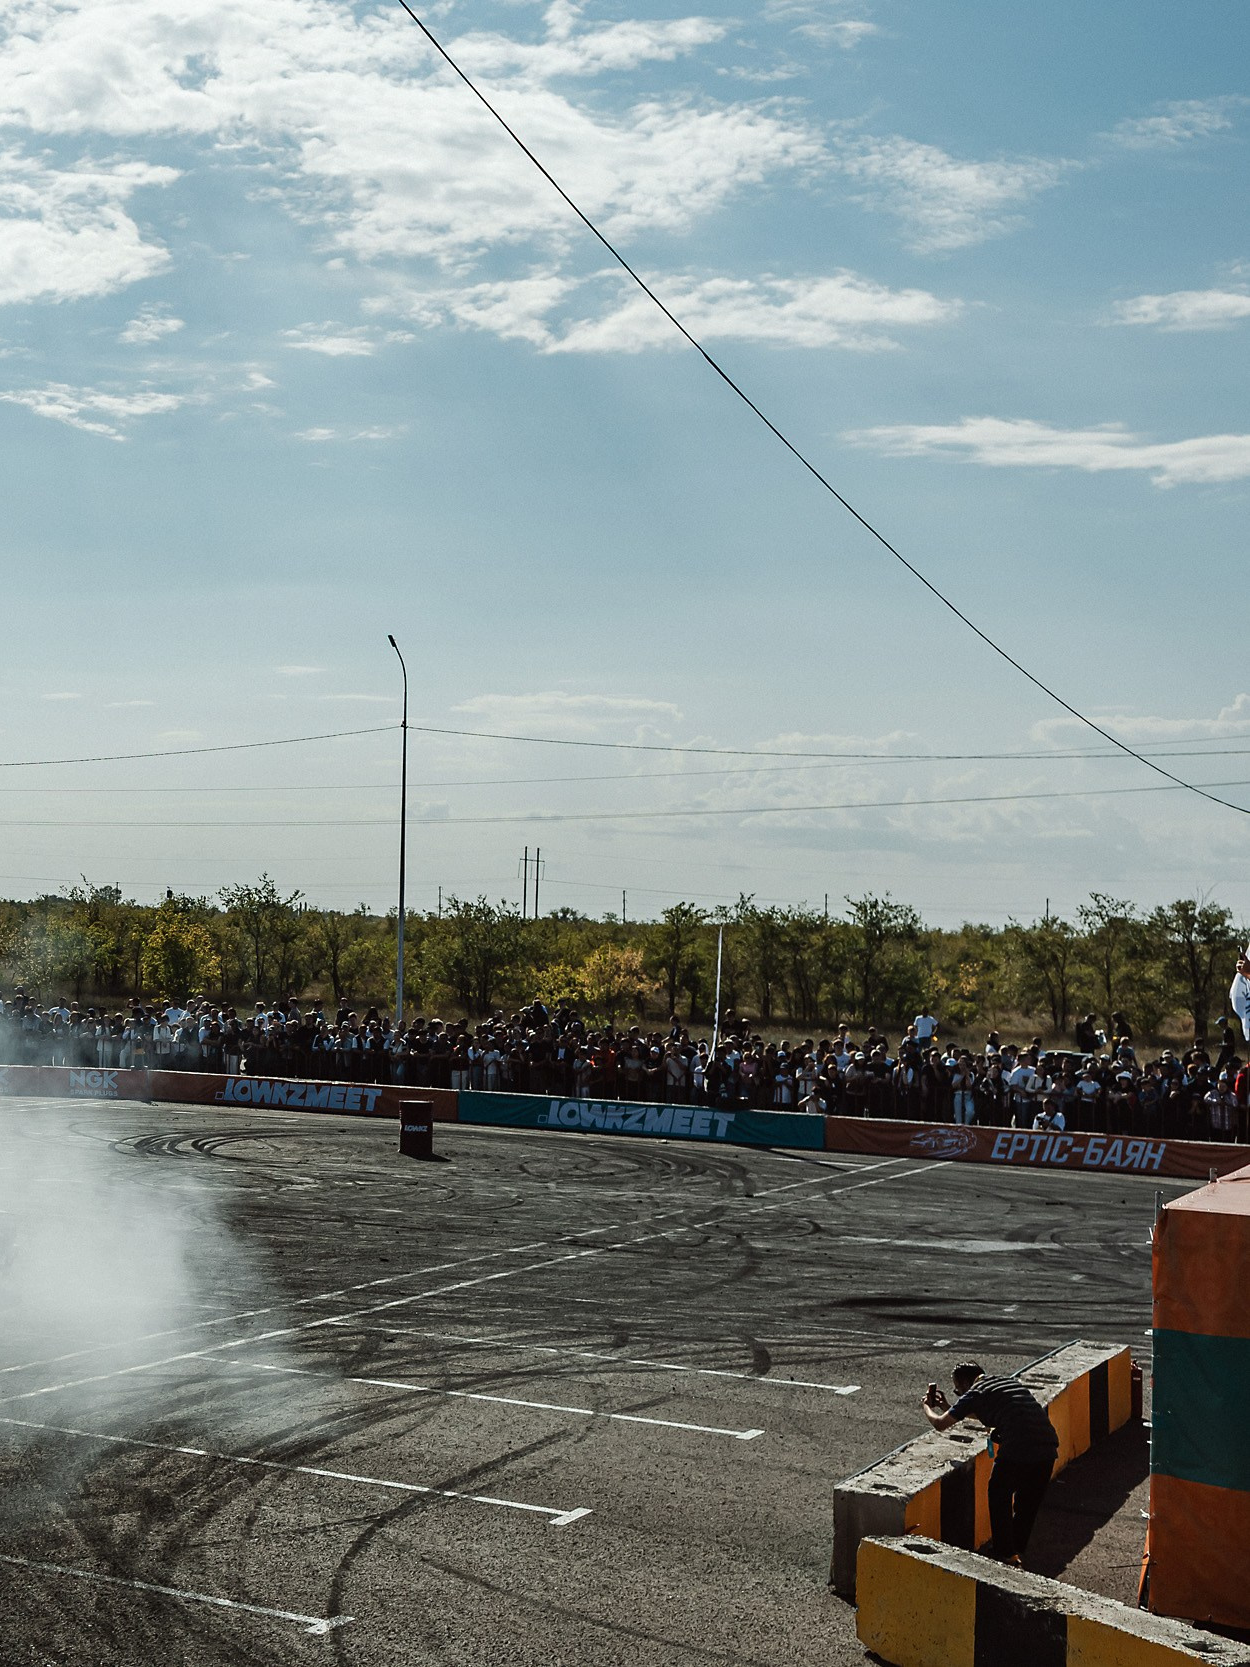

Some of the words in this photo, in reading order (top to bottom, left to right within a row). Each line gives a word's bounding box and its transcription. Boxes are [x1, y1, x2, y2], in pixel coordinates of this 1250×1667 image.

[69, 1070, 119, 1089] NGK
[224, 1078, 383, 1112] LOWKZMEET
[404, 1124, 428, 1133] LOWKZ
[547, 1100, 736, 1138] LOWKZMEET
[991, 1132, 1166, 1170] ЕРТІС-БАЯН
